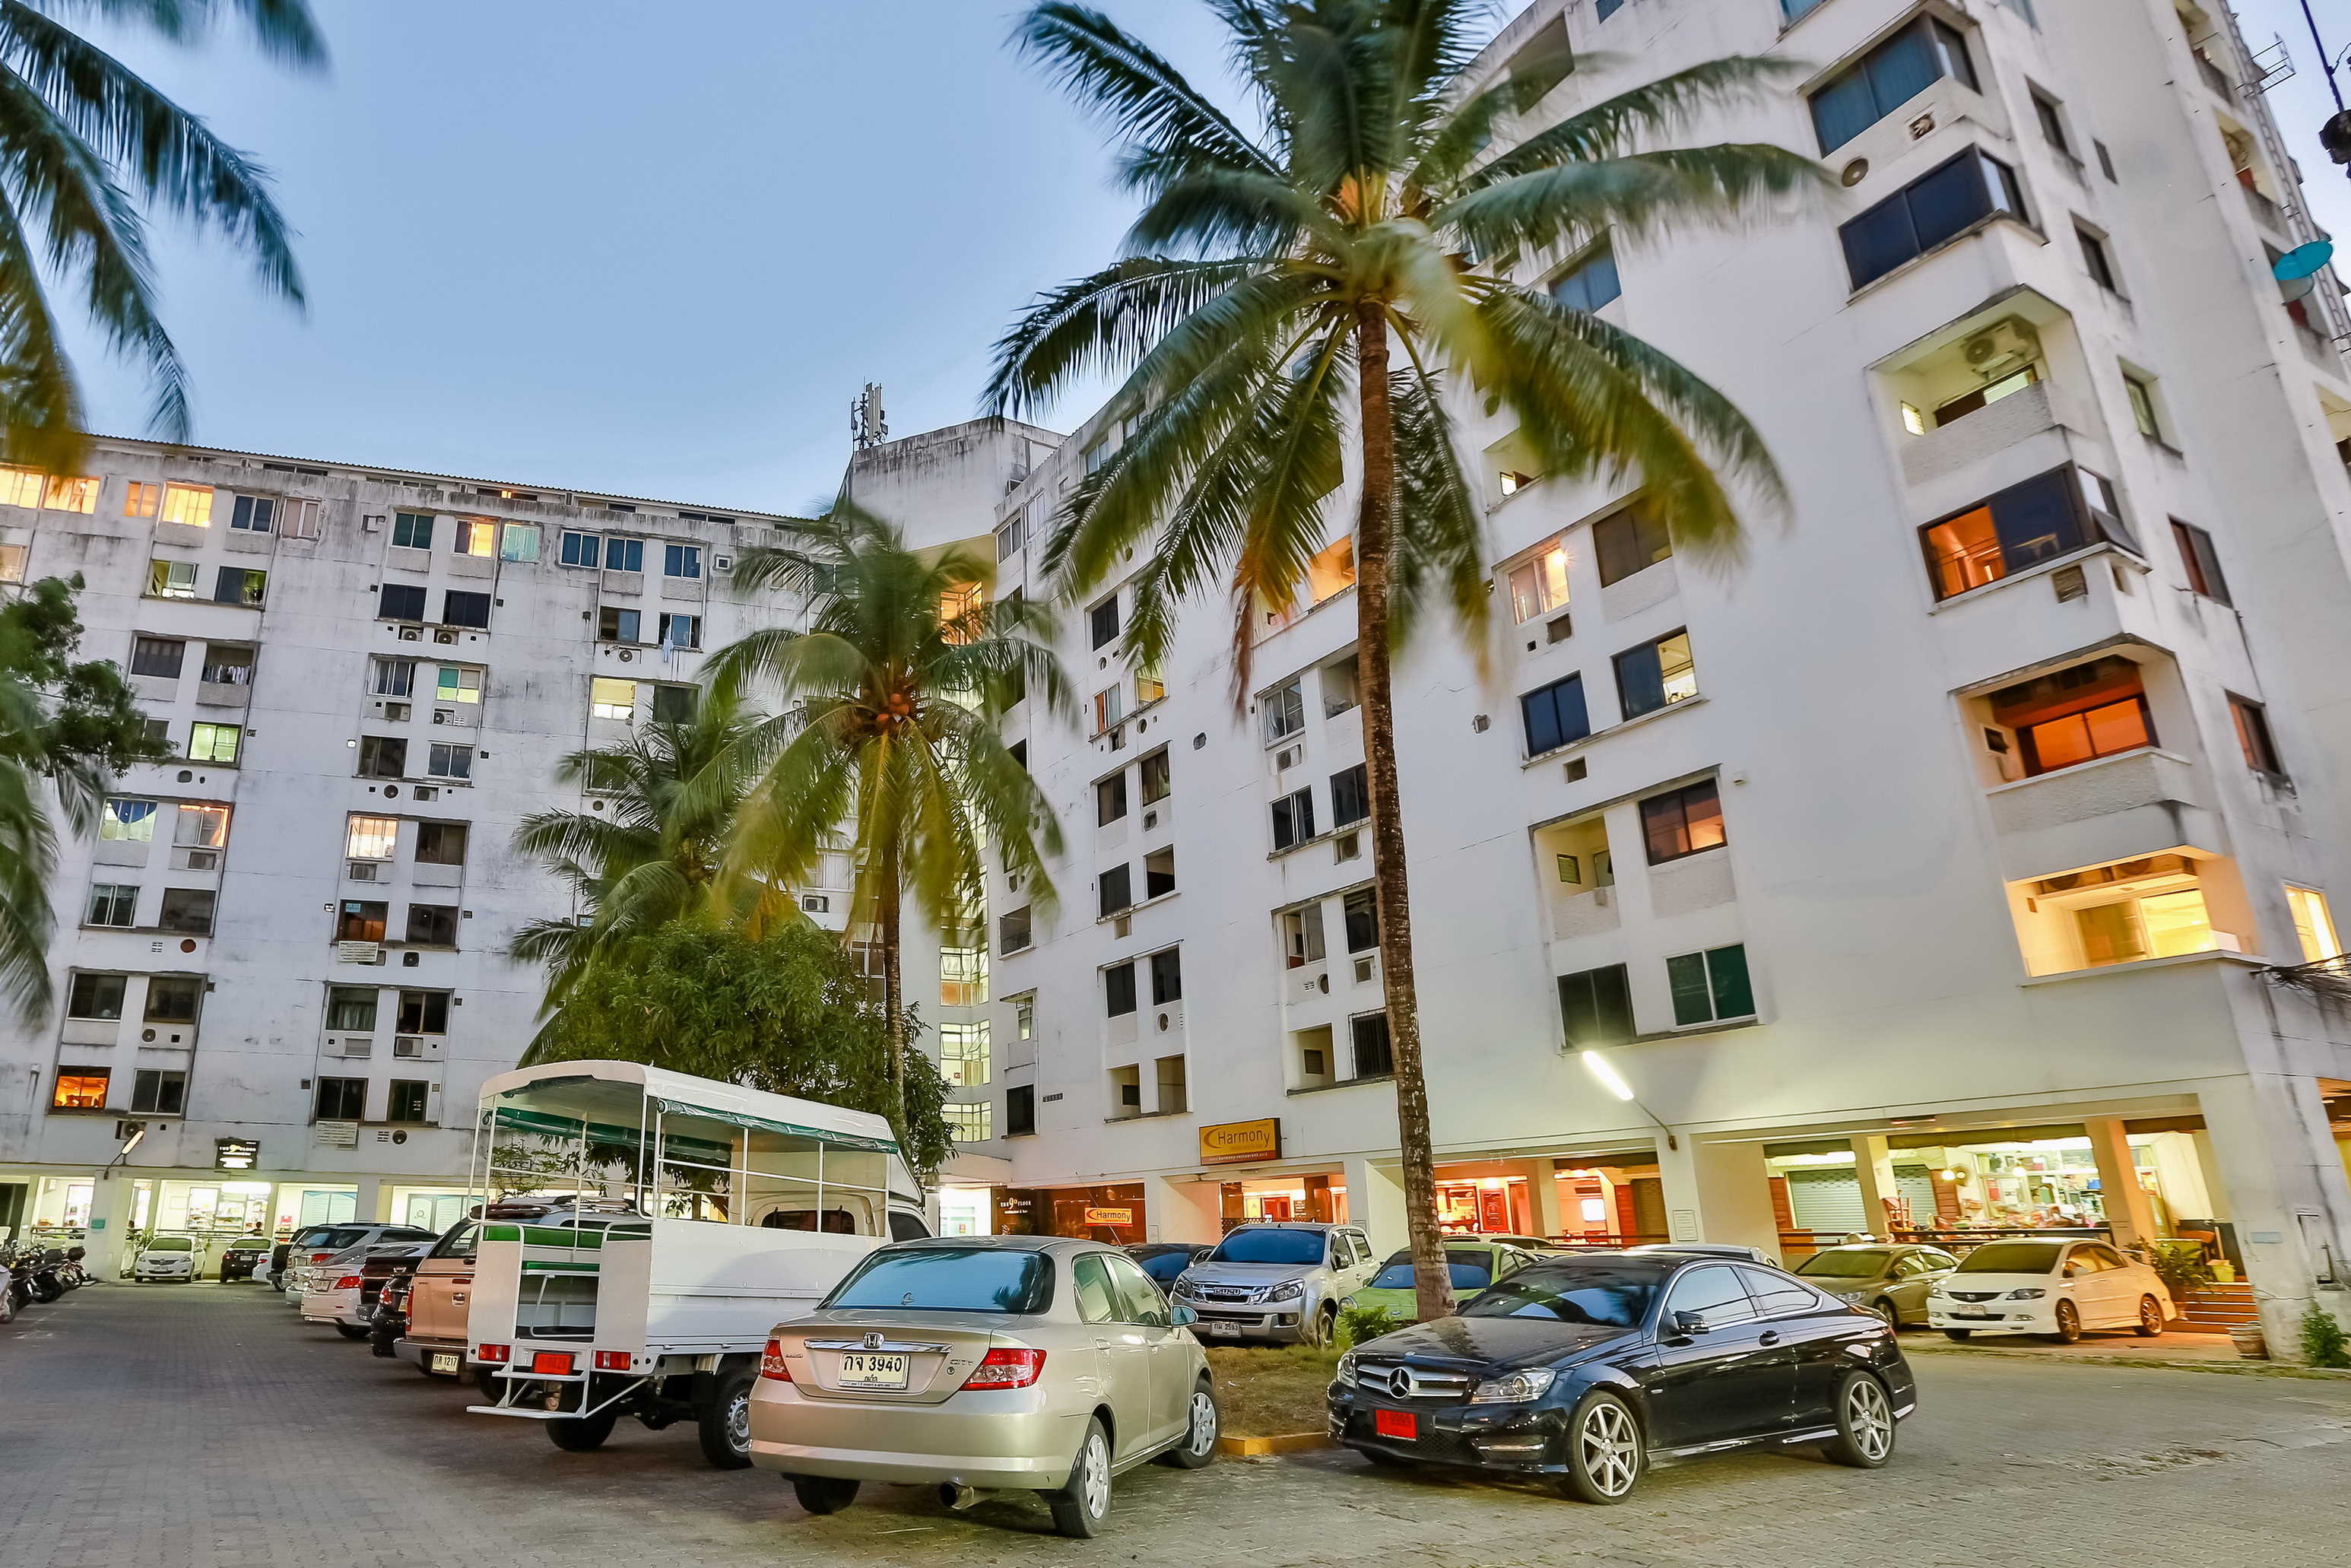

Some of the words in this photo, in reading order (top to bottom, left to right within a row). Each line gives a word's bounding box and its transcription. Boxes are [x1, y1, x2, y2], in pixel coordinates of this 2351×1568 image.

[1217, 1129, 1271, 1148] Harmony
[1096, 1210, 1131, 1223] Harmony
[444, 1356, 458, 1366] 1217
[843, 1355, 864, 1371] กจ
[868, 1356, 903, 1373] 3940
